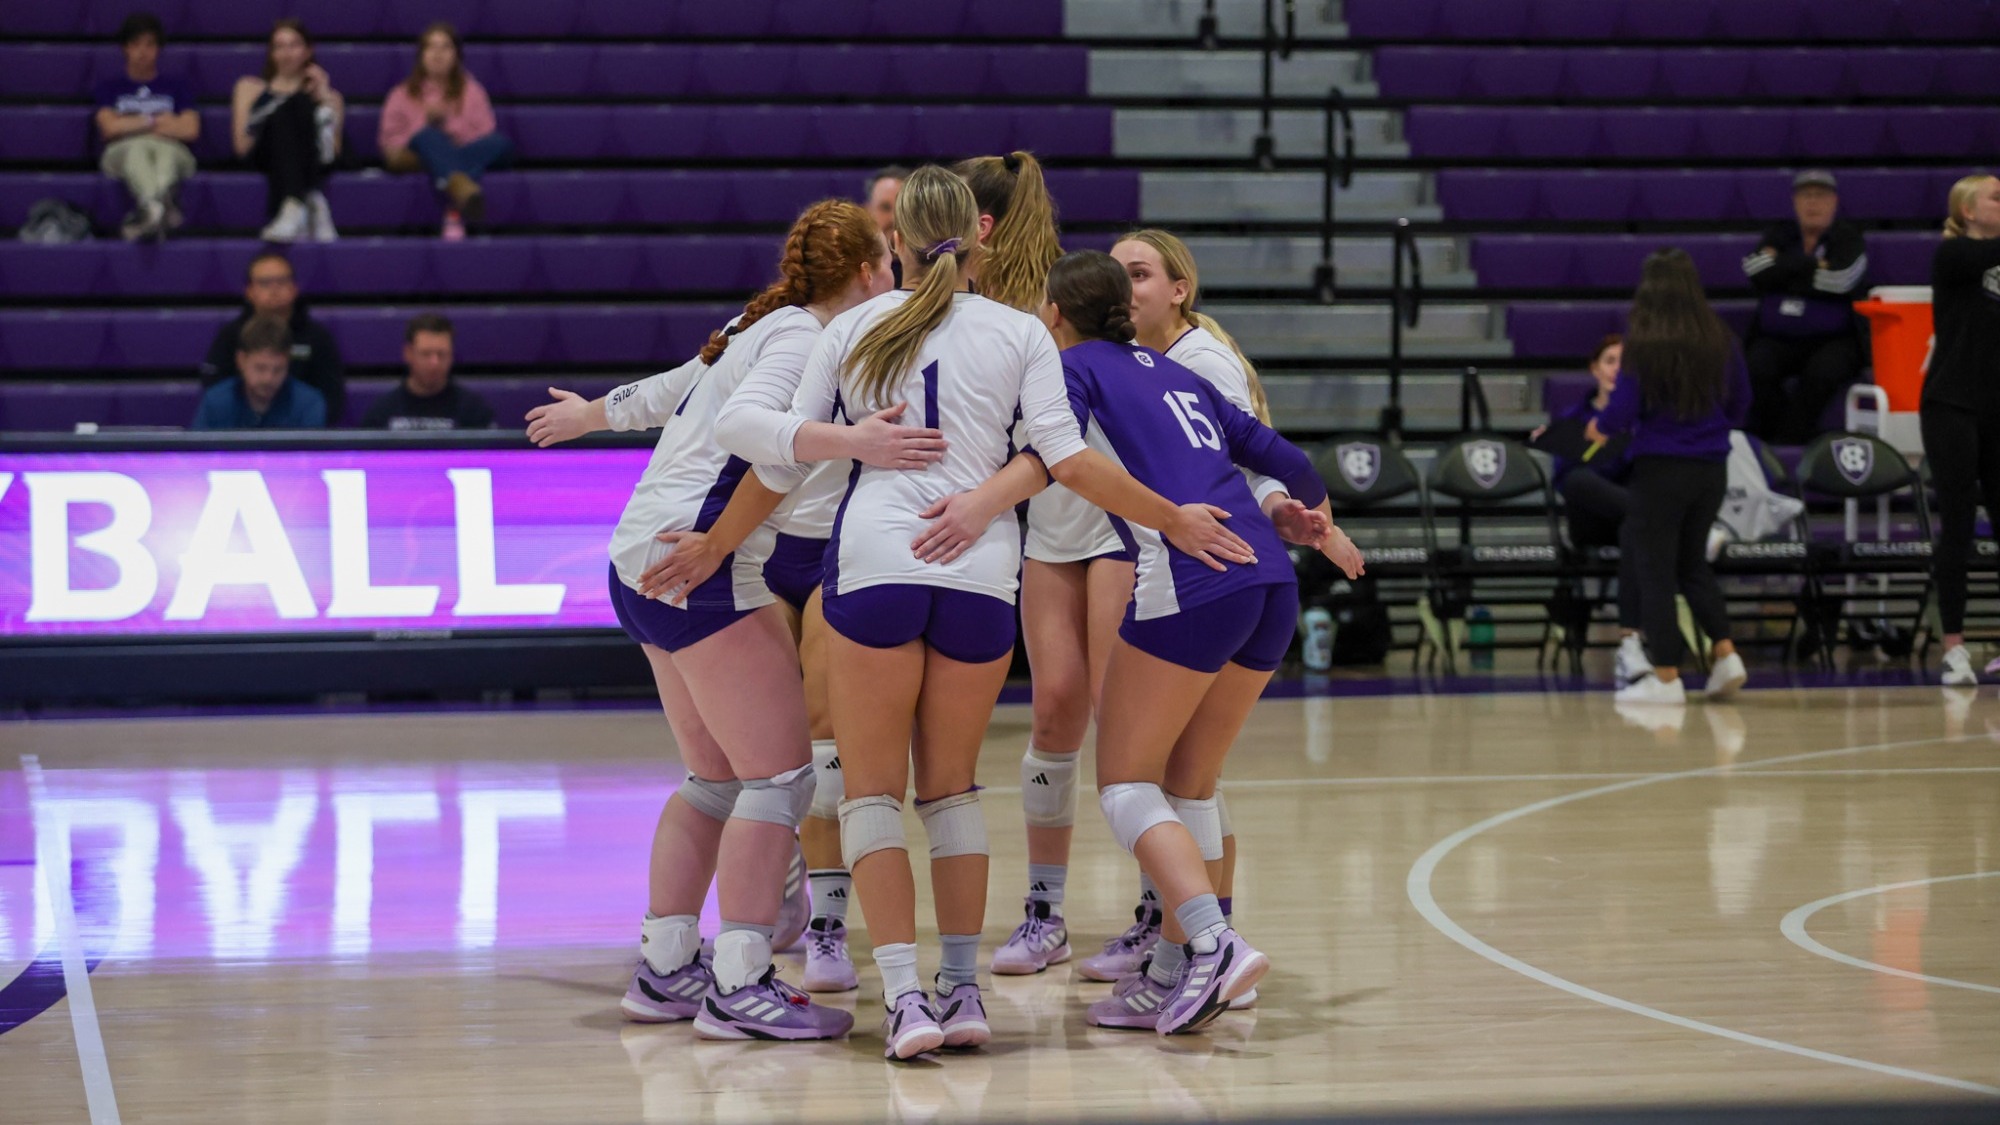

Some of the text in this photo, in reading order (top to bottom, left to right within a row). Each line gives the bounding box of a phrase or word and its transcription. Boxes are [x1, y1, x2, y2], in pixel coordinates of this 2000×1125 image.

[920, 358, 940, 430] 1
[1162, 390, 1222, 451] 15
[1473, 545, 1557, 562] CRUSADERS
[1726, 542, 1808, 559] CRUSADERS
[1853, 541, 1933, 557] CRUSADERS
